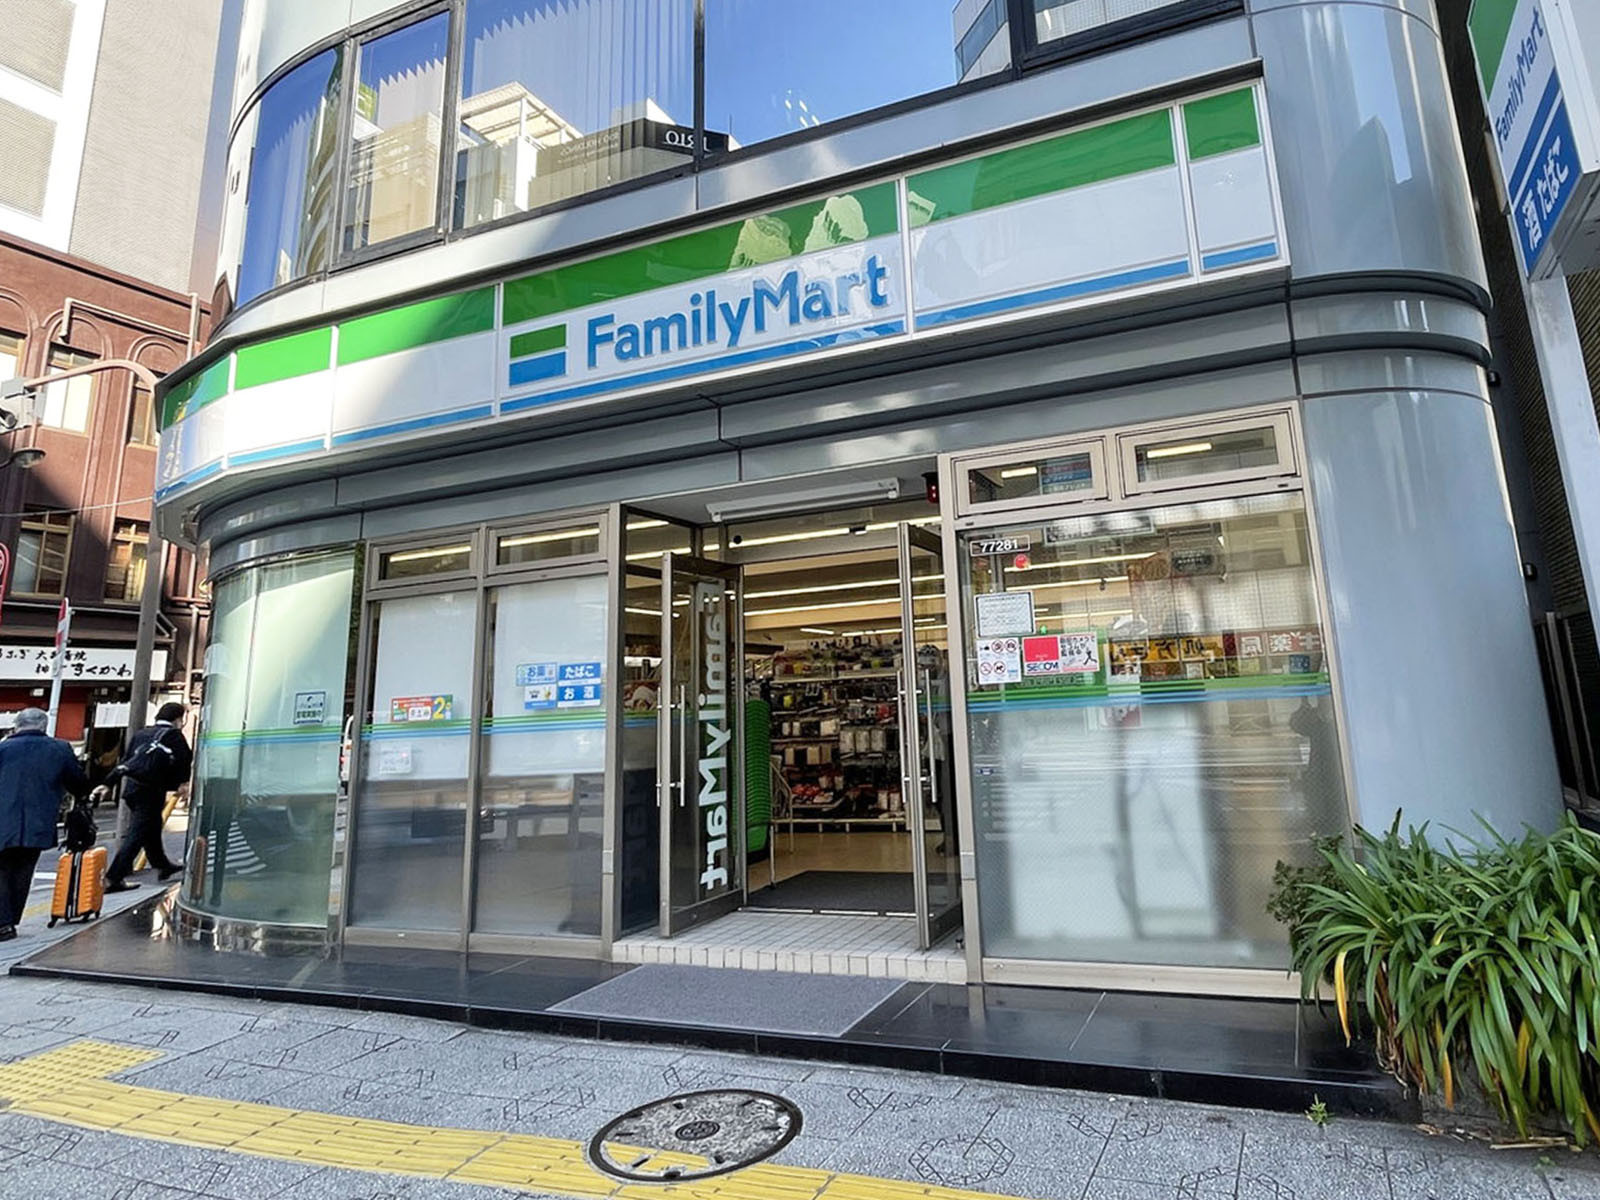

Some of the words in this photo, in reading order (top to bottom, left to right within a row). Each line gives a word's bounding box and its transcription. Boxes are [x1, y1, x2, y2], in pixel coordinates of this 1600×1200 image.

[1496, 6, 1544, 153] FamilyMart
[1523, 188, 1543, 251] 酒
[1536, 136, 1569, 221] たばこ
[587, 255, 890, 369] FamilyMart
[981, 540, 1018, 553] 77281
[565, 665, 595, 679] たばこ
[1027, 662, 1059, 672] SECOM
